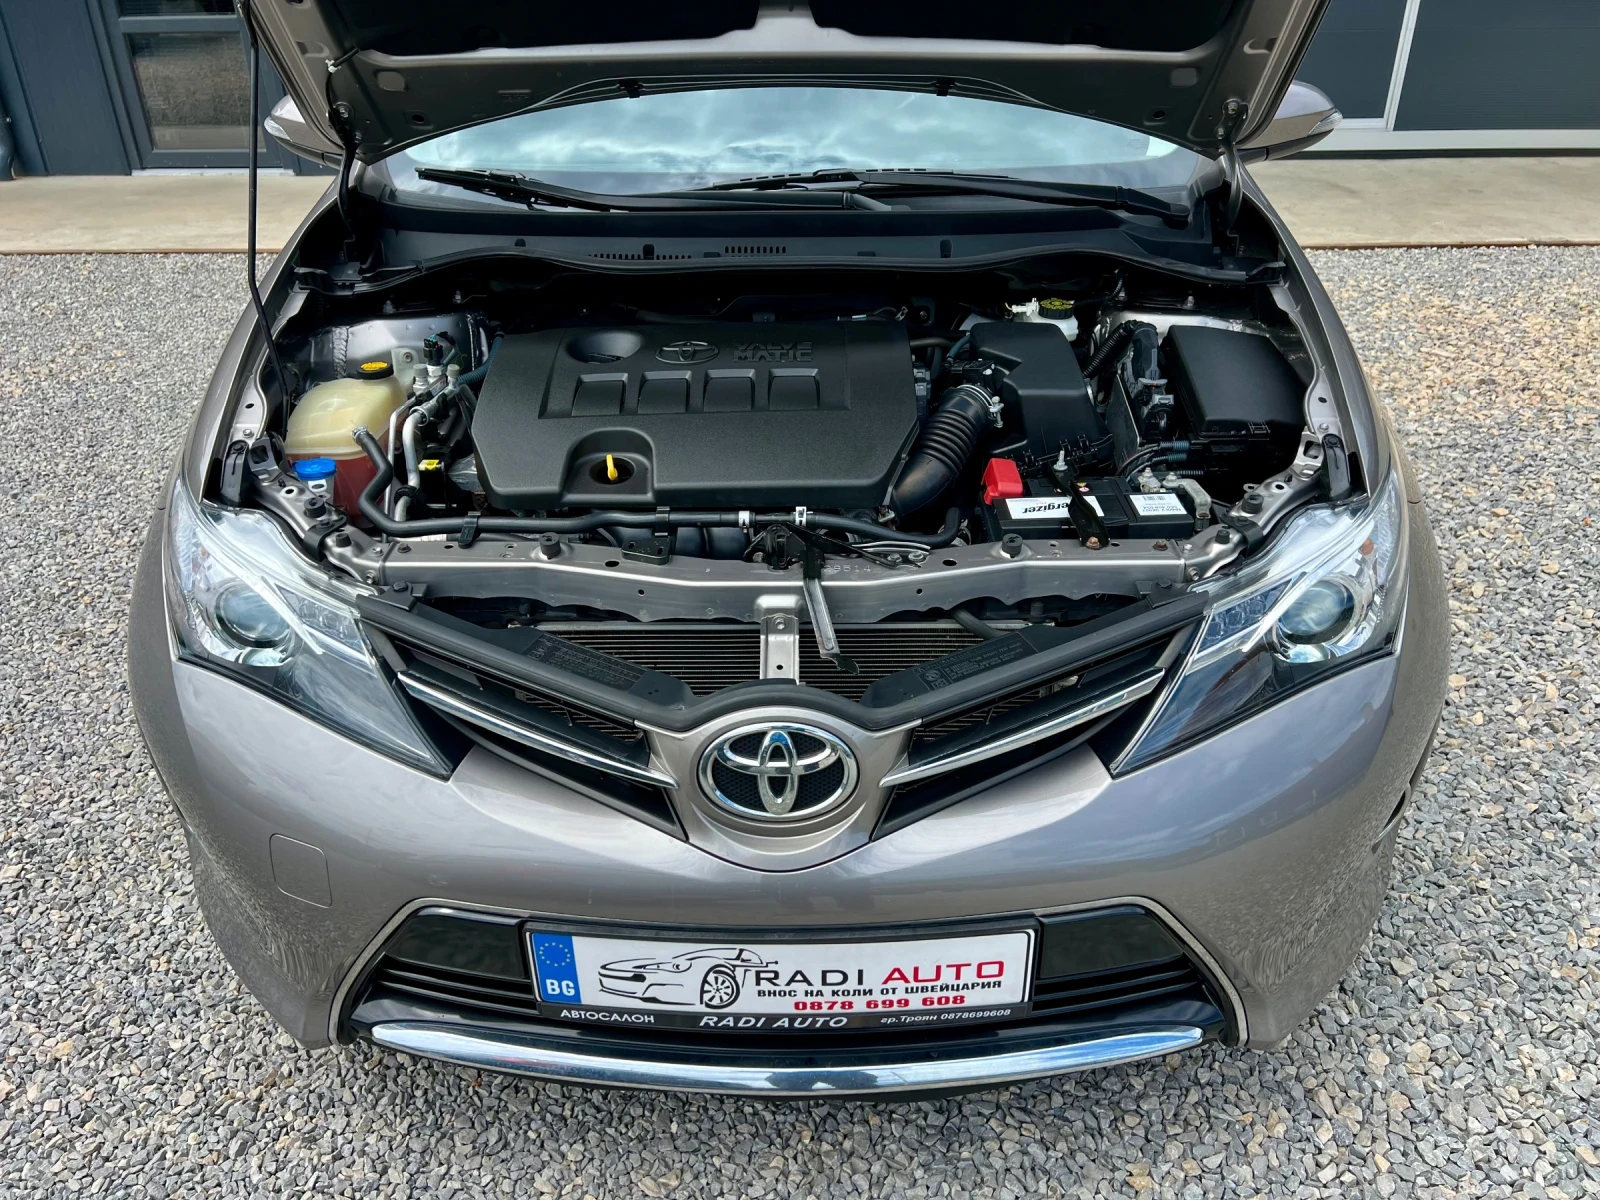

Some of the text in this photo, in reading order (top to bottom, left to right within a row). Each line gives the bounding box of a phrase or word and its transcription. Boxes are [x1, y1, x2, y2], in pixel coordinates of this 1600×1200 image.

[1022, 502, 1070, 514] ergizer
[755, 960, 1005, 987] RADI AUTO
[545, 979, 576, 996] BG
[757, 980, 1002, 998] ВНОС НА КОЛИ ОТ ШВЕЙЦАРИЯ
[794, 995, 966, 1011] 0878 699 608
[560, 1009, 655, 1023] АВТОСАЛОН
[699, 1016, 848, 1028] RADI AUTO
[940, 1009, 1012, 1020] 0878699608
